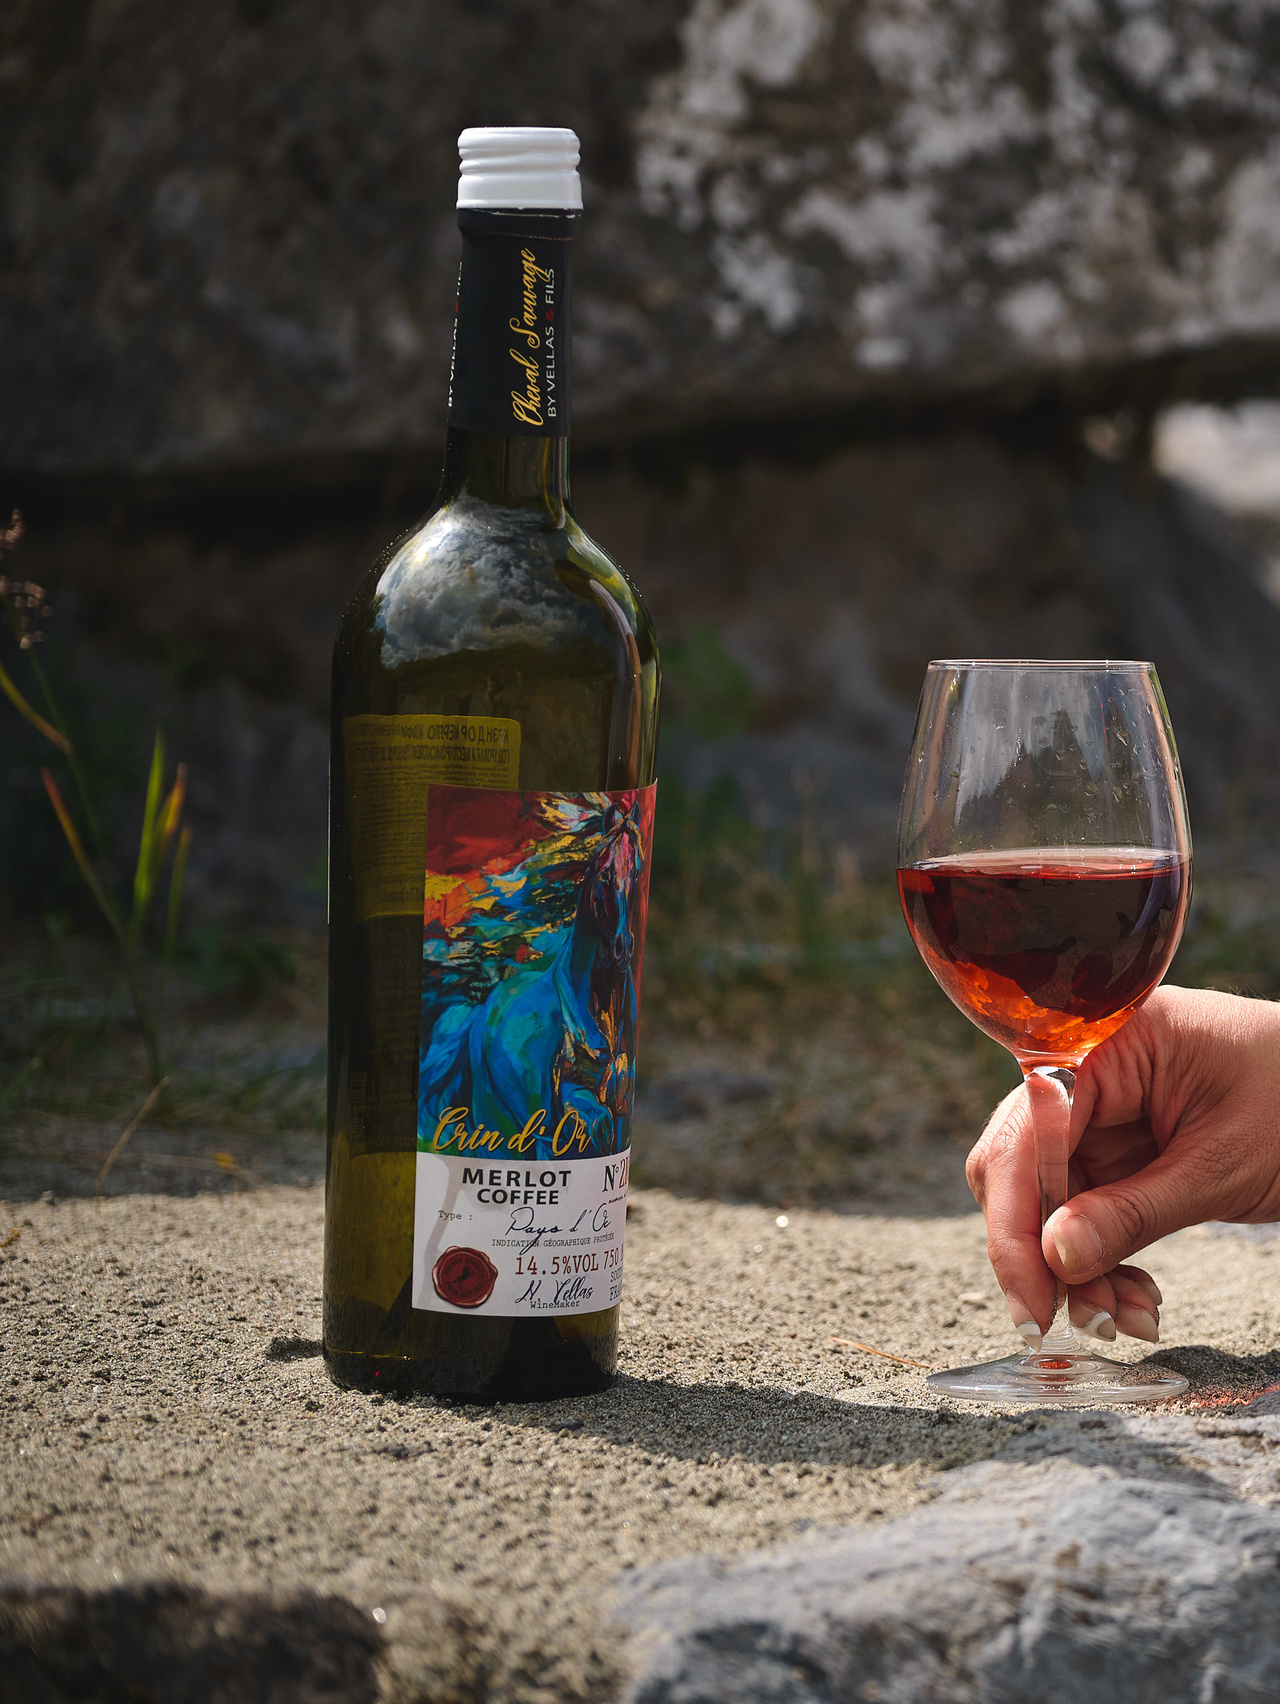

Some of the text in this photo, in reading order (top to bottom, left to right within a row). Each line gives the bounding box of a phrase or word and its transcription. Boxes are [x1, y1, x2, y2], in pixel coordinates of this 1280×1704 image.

[509, 247, 551, 426] Cheval Sauvage
[545, 268, 557, 417] BY VELLAS & FILS
[432, 1106, 504, 1152] Crin
[461, 1167, 572, 1187] MERLOT
[476, 1188, 560, 1205] COFFEE
[438, 1210, 462, 1221] Type
[505, 1206, 563, 1256] Pays
[492, 1238, 540, 1248] INDICATION
[543, 1236, 591, 1248] GÉOGRAPHIQUE
[603, 1247, 619, 1270] 750
[529, 1299, 581, 1310] WineMaker
